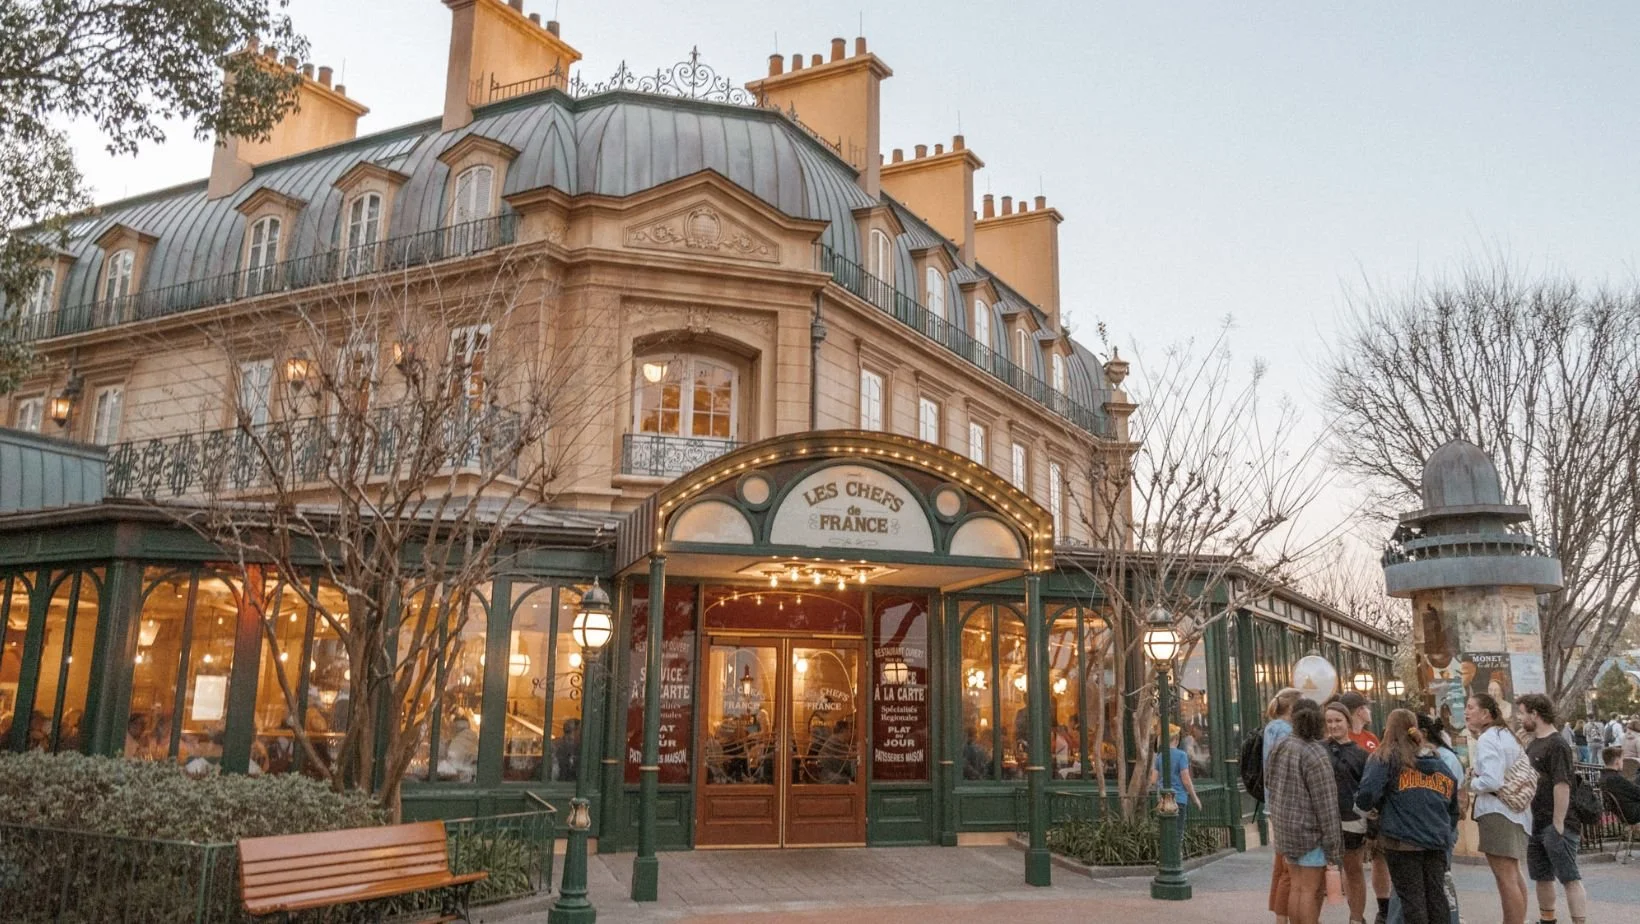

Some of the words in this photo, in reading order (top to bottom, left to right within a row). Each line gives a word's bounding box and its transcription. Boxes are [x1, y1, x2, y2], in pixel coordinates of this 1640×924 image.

[802, 482, 839, 507] LES
[845, 481, 904, 513] CHEFS
[847, 505, 861, 516] de
[819, 514, 889, 533] FRANCE
[1472, 655, 1503, 663] MONET
[640, 667, 683, 681] SVICE
[660, 685, 690, 699] ARTE
[883, 687, 894, 701] LA
[897, 687, 924, 701] CARTE
[807, 702, 842, 710] FRANCE
[884, 739, 915, 747] JOUR
[665, 748, 687, 763] MAISON
[905, 748, 924, 763] MAISON
